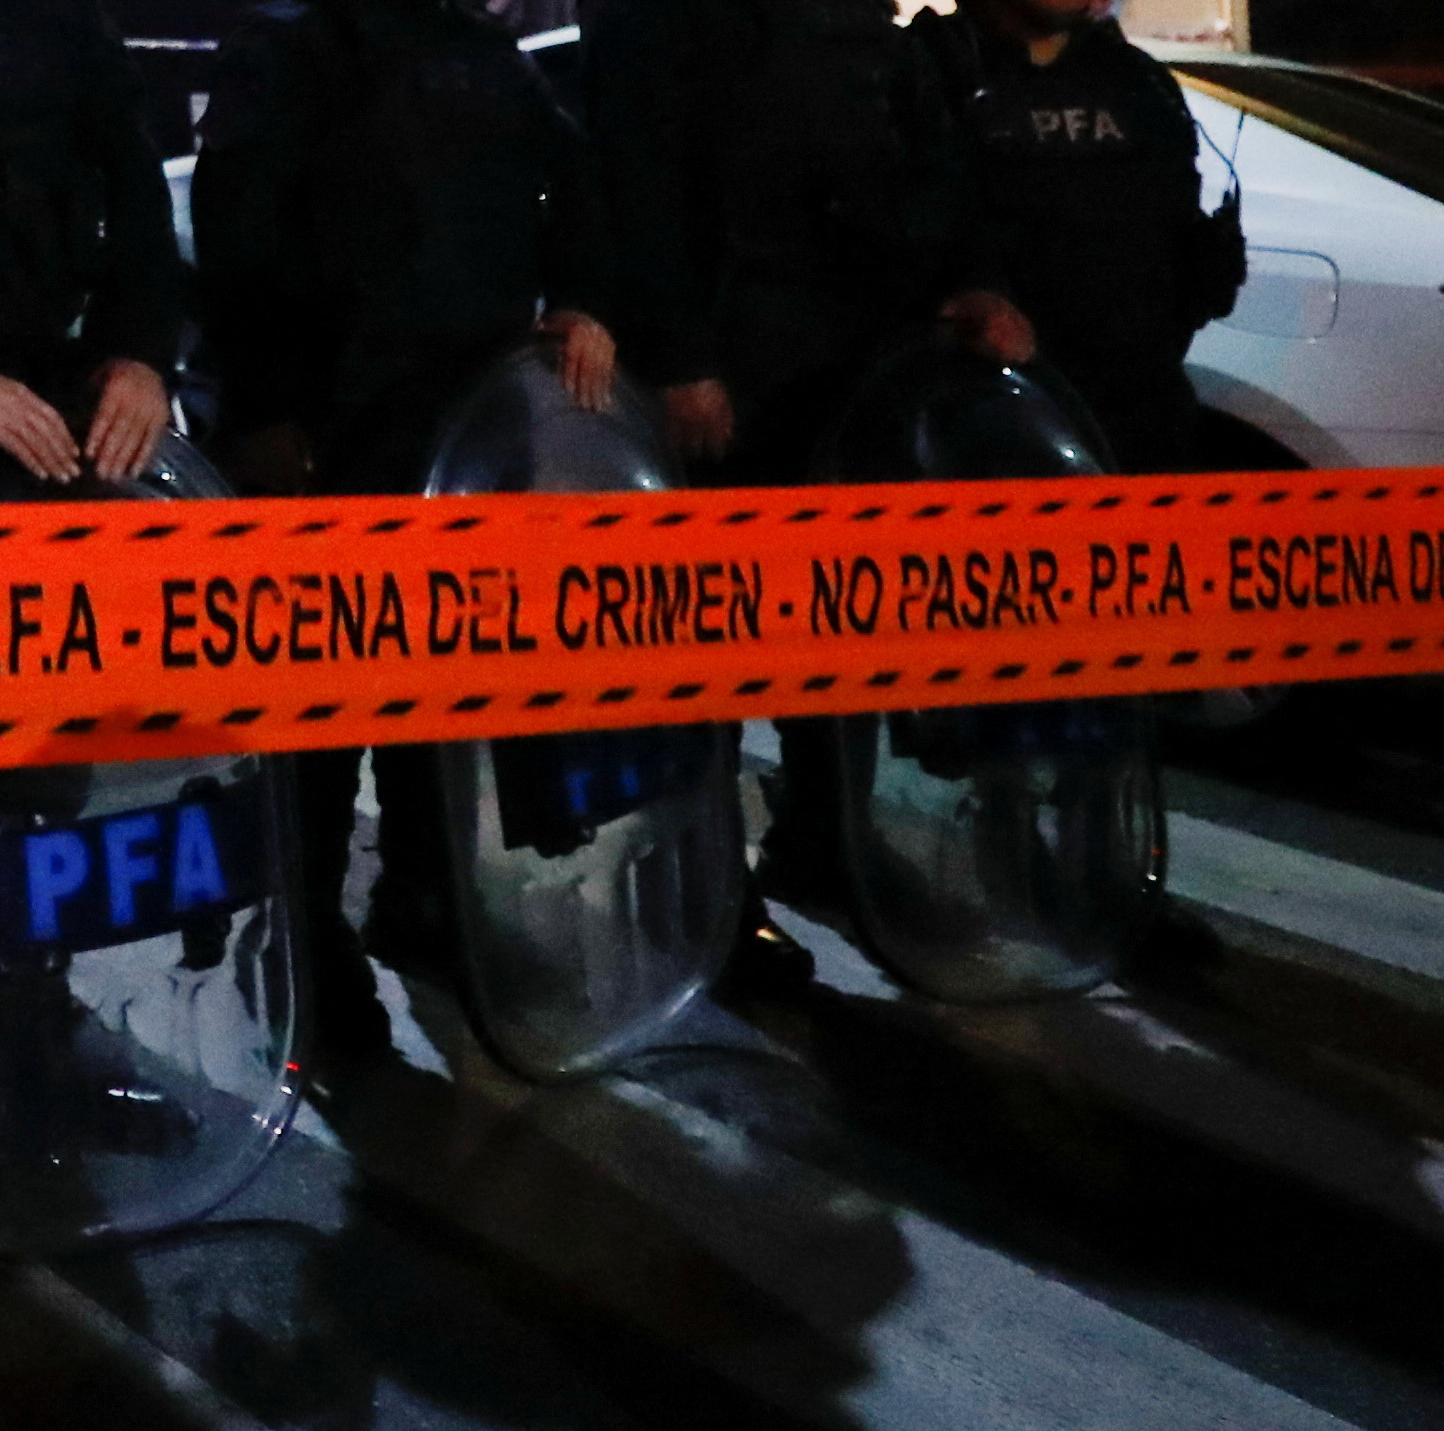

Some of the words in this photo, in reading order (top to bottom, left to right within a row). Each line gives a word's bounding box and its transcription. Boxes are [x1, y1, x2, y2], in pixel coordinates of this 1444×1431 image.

[1030, 107, 1124, 142] PFA
[162, 572, 410, 669] ESCENA
[428, 569, 538, 656] DEL
[556, 562, 762, 650] CRIMEN
[811, 556, 883, 635] NO
[1229, 535, 1399, 612] ESCENA
[1410, 531, 1444, 604] D
[23, 802, 231, 942] PFA
